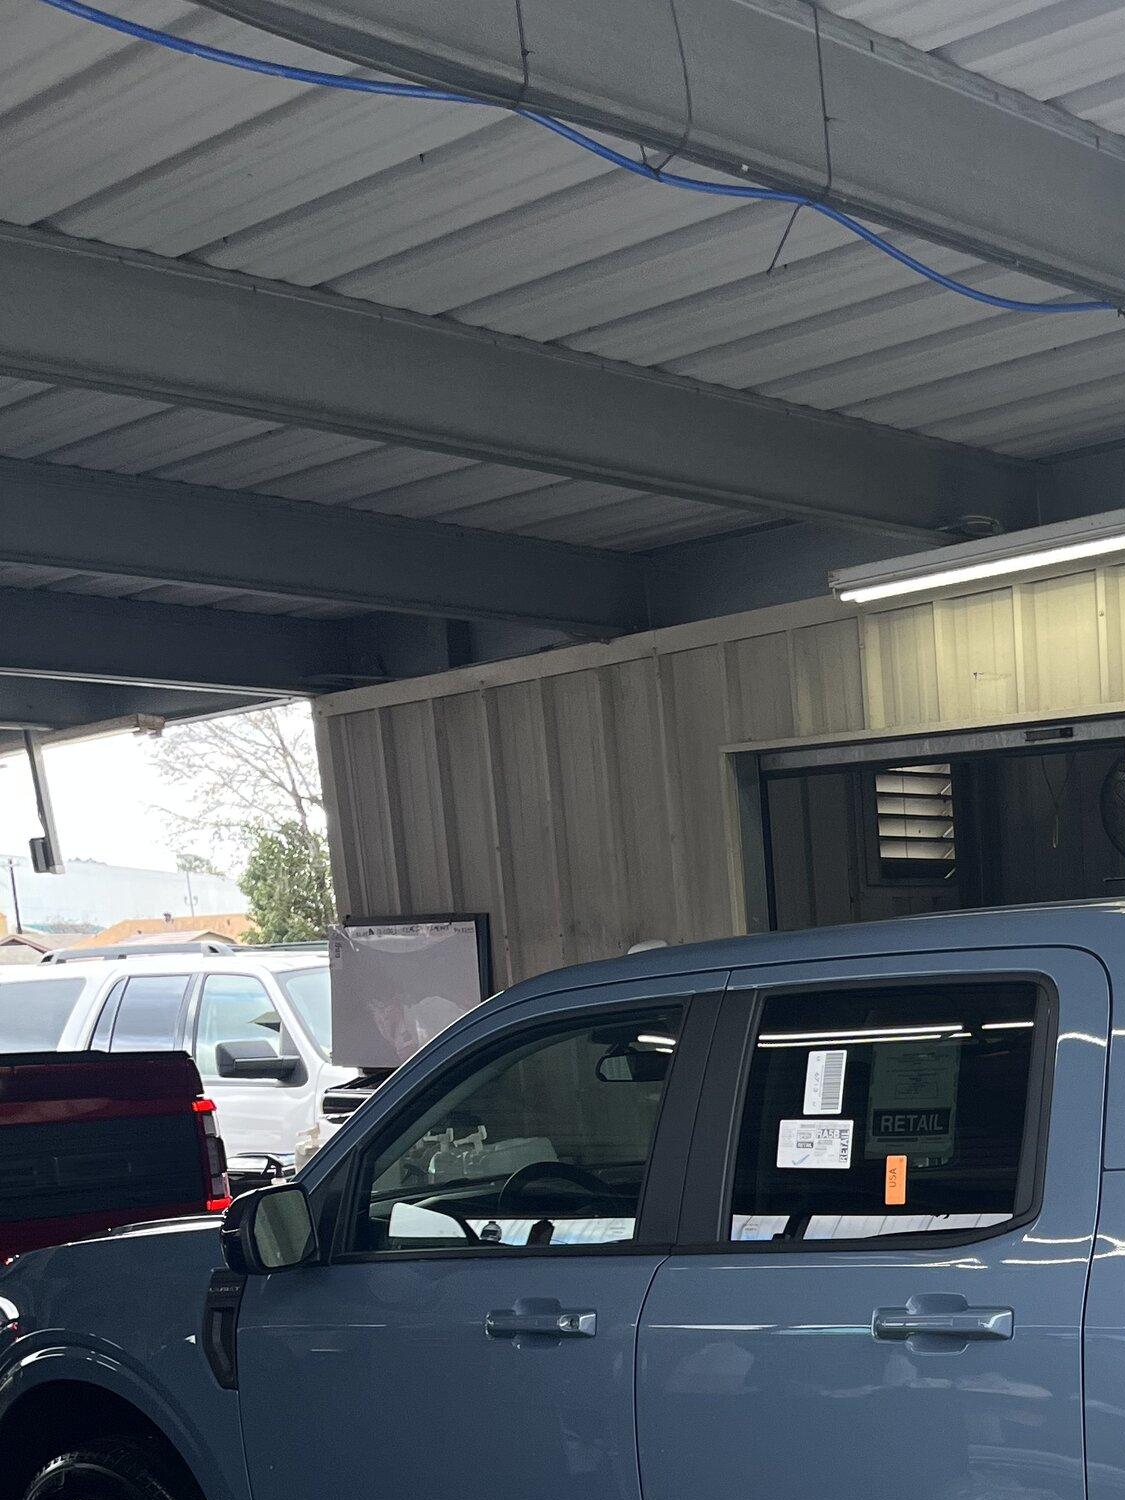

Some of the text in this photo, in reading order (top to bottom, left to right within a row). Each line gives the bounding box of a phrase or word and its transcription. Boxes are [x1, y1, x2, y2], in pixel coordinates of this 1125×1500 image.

[881, 1114, 944, 1132] RETAIL
[840, 1130, 850, 1163] RETAIL
[889, 1167, 897, 1187] USA
